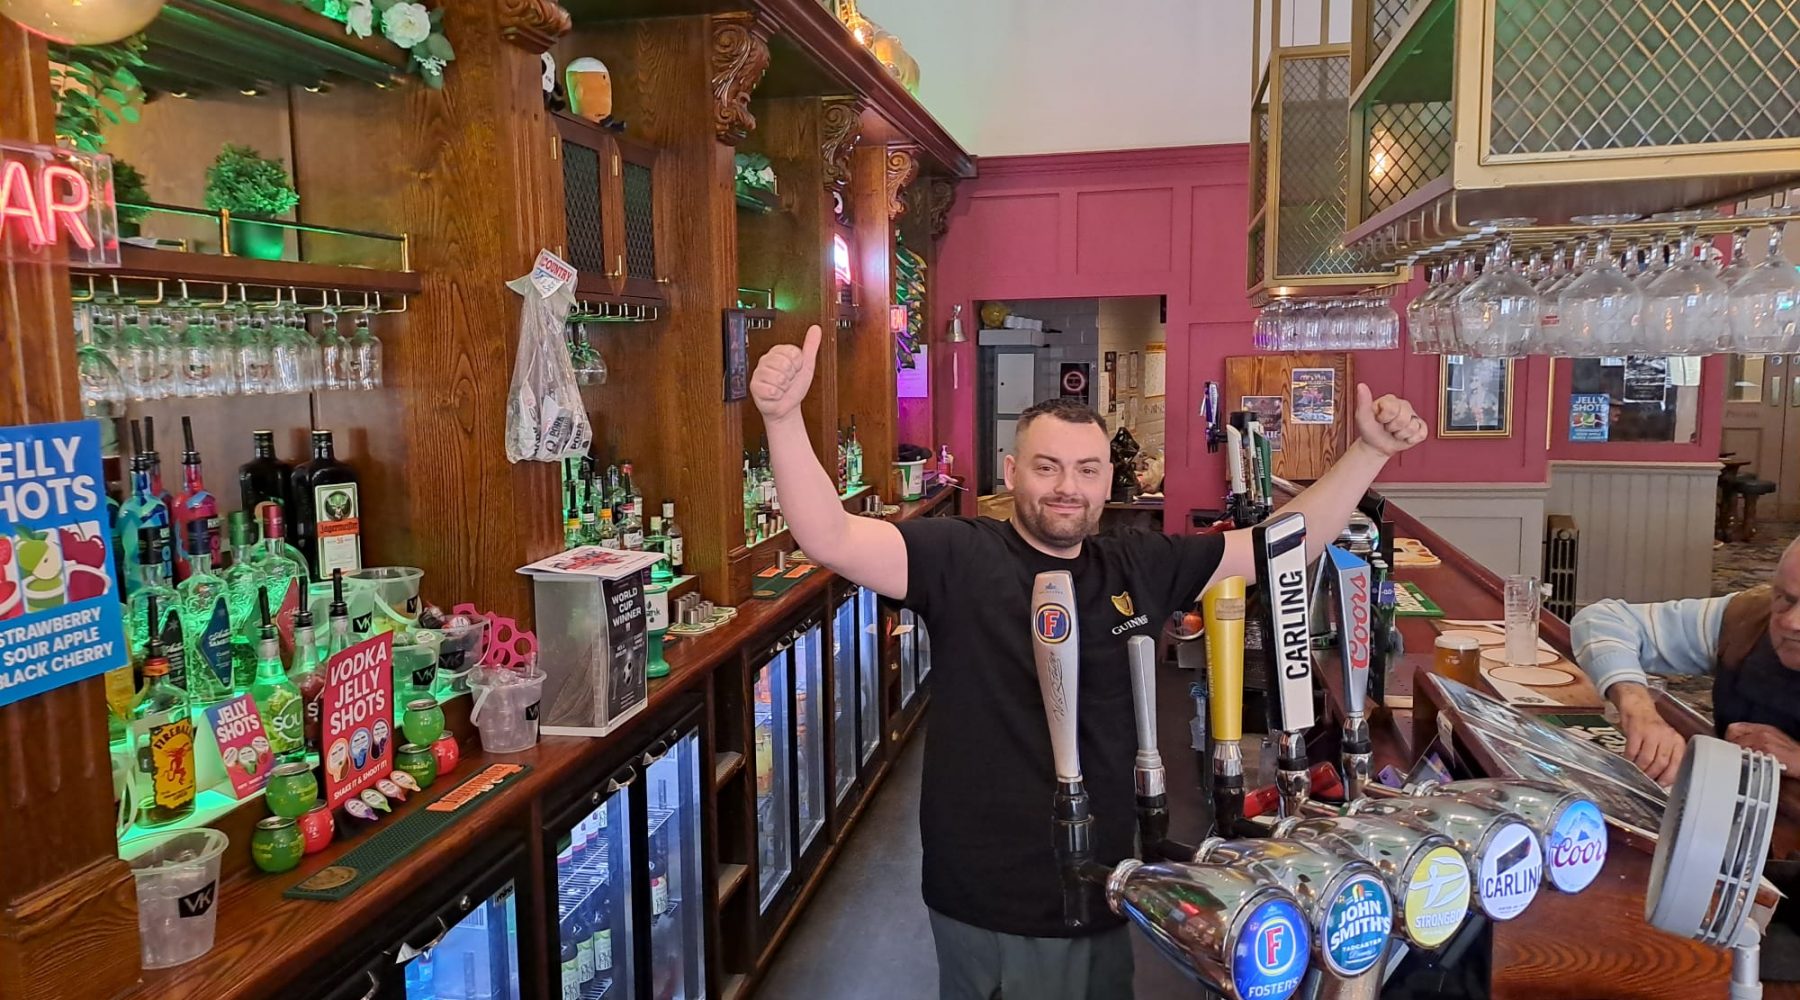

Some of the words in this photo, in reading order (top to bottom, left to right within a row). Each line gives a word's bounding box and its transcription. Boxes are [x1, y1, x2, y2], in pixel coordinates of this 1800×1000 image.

[540, 256, 572, 282] COUNTRY
[1572, 404, 1607, 412] SHOTS
[1575, 396, 1604, 404] JELLY
[612, 587, 638, 605] WORLD
[619, 600, 634, 613] CUP
[0, 606, 101, 648] STRAWBERRY
[356, 615, 372, 630] VK
[612, 607, 642, 628] WINNER
[1043, 610, 1060, 637] F
[1279, 570, 1310, 680] CARLING
[1349, 572, 1369, 671] Coors
[3, 641, 50, 667] SOUR
[53, 626, 101, 653] APPLE
[0, 661, 49, 690] BLACK
[51, 641, 113, 672] CHERRY
[330, 641, 388, 687] VODKA
[416, 668, 435, 682] VK
[334, 666, 381, 709] JELLY
[217, 700, 249, 725] JELLY
[330, 689, 386, 735] SHOTS
[216, 713, 260, 743] SHOTS
[333, 785, 352, 800] SHAKE
[362, 768, 378, 783] SHOOT
[184, 888, 212, 913] VK
[1338, 900, 1381, 929] JOHN
[1265, 926, 1284, 967] F
[1331, 917, 1391, 952] SMITH'S
[1342, 938, 1382, 952] TADCASTER
